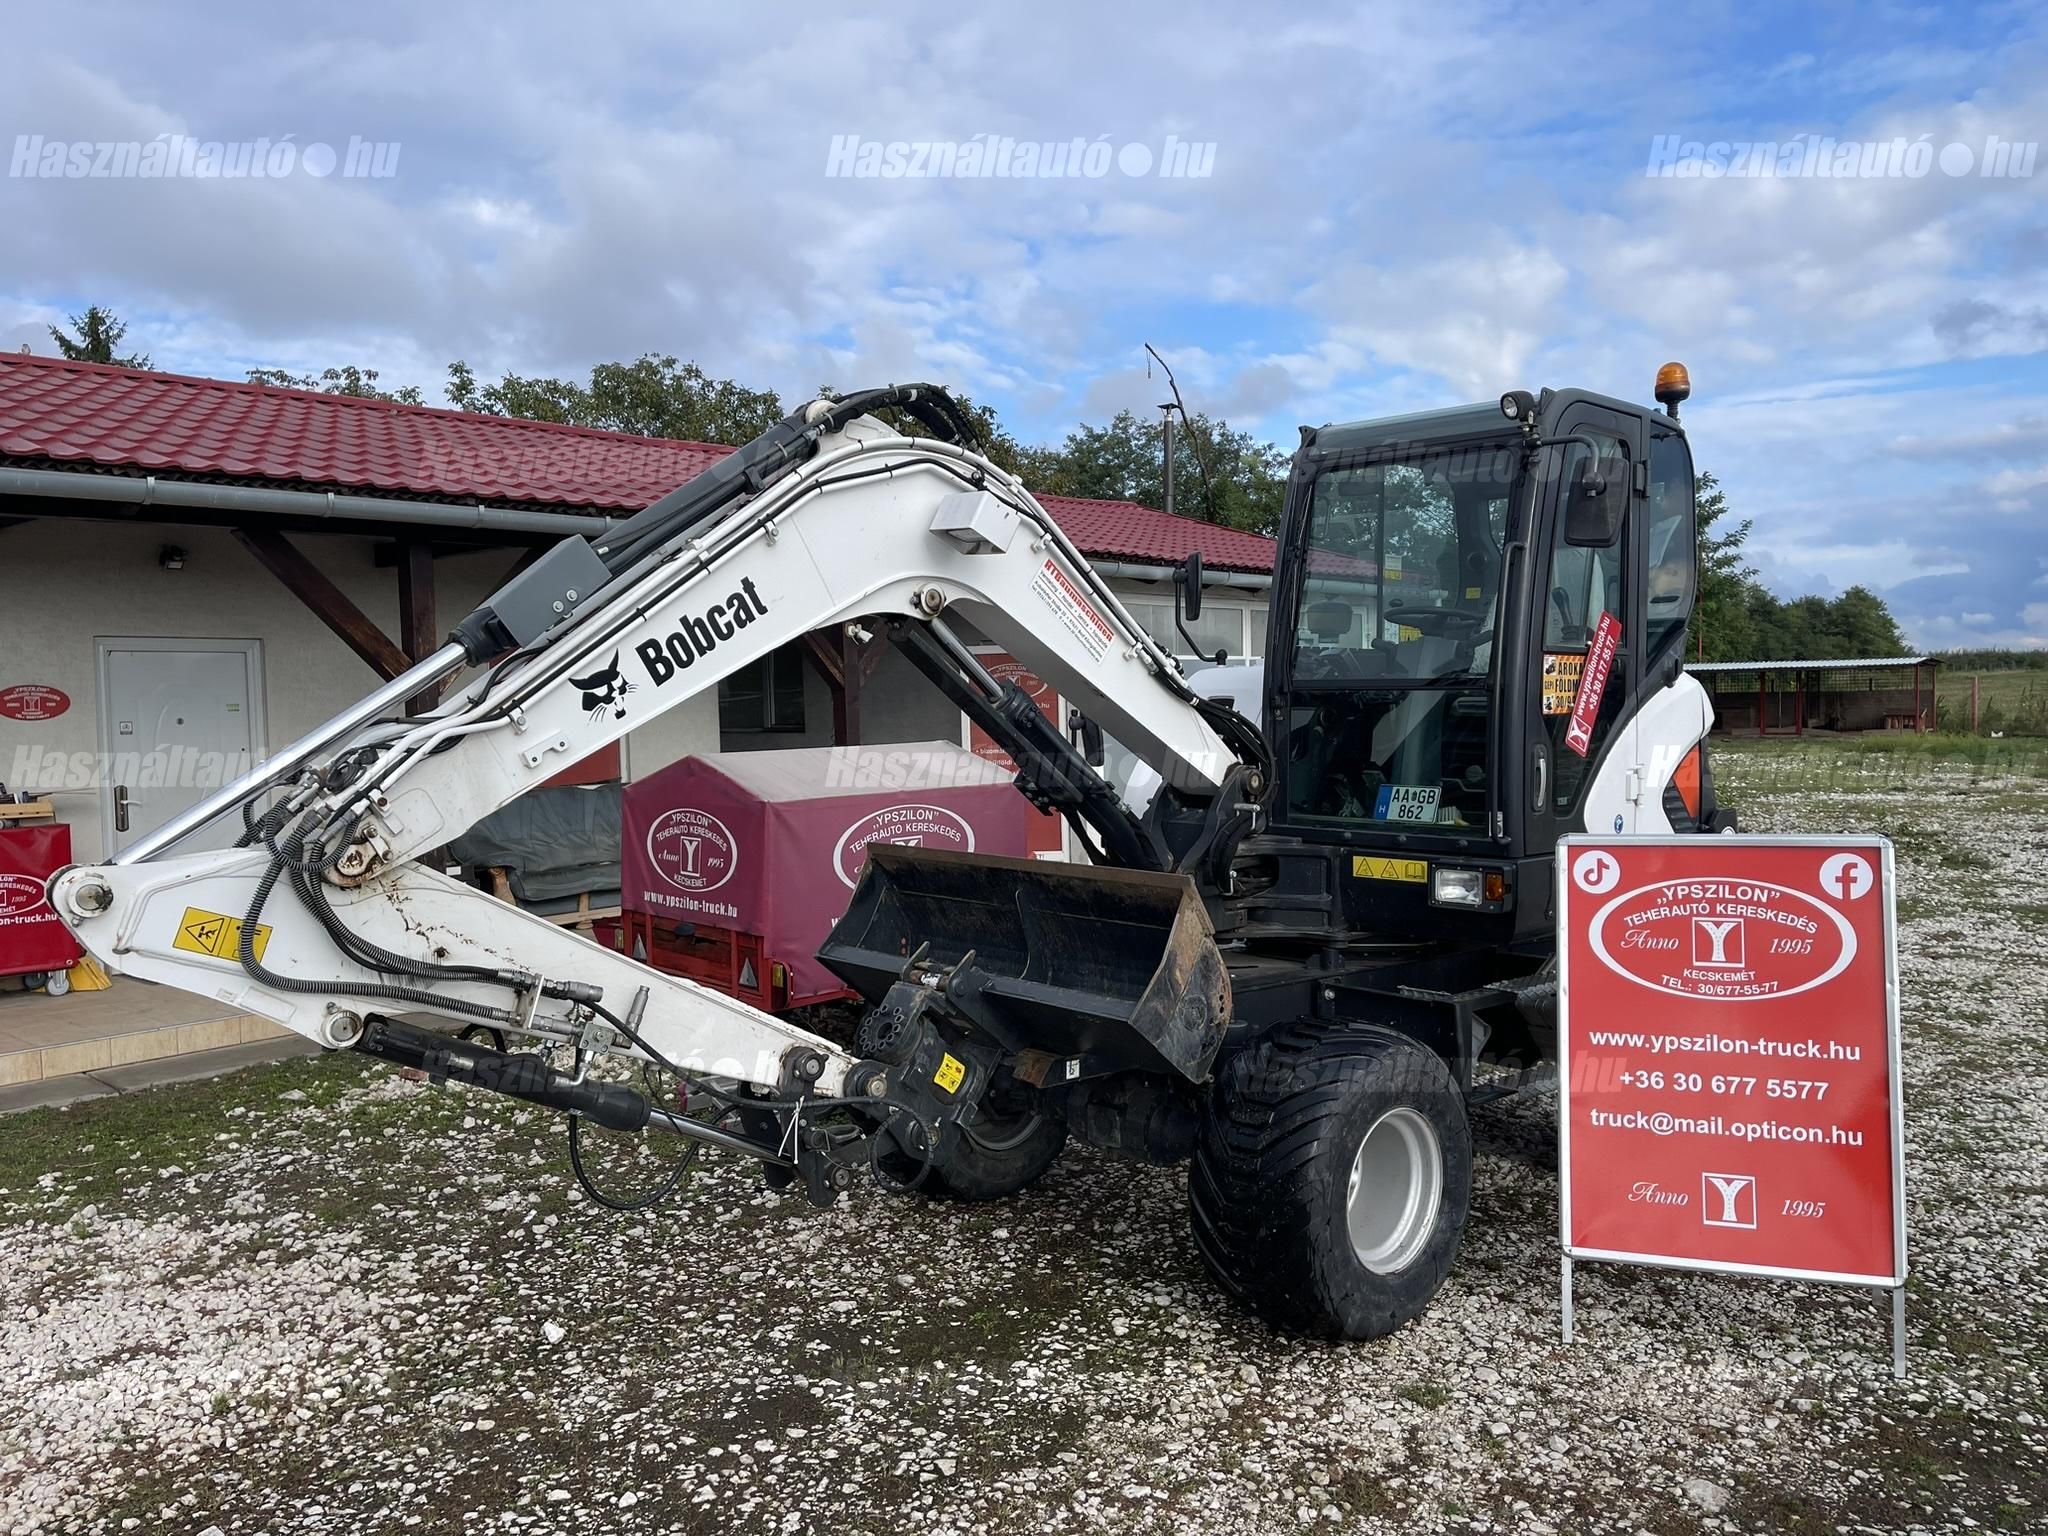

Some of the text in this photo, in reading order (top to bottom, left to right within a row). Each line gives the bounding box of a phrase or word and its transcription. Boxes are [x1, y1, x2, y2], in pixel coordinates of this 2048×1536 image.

[634, 576, 769, 687] Bobcat
[1577, 616, 1610, 716] www.ypszilon-truck.hu
[1392, 788, 1436, 804] AA GB
[1398, 804, 1424, 820] 862
[906, 823, 961, 842] KERESKEDÉS
[643, 891, 738, 917] www.ypszilon-truck.hu
[1624, 900, 1818, 934] TEHERAUTÓ KERESKEDÉS
[1620, 929, 1680, 950] Anno
[1769, 937, 1814, 955] 1995
[1683, 968, 1756, 982] KECSKEMÉT
[1697, 981, 1778, 995] 30/677-55-77
[1589, 1031, 1861, 1061] www.ypszilon-truck.hu
[1619, 1070, 1830, 1101] +36 30 677 5577
[1590, 1108, 1864, 1146] truck@mail.opticon.hu
[1627, 1181, 1689, 1206] Anno
[1781, 1199, 1826, 1219] 1995
